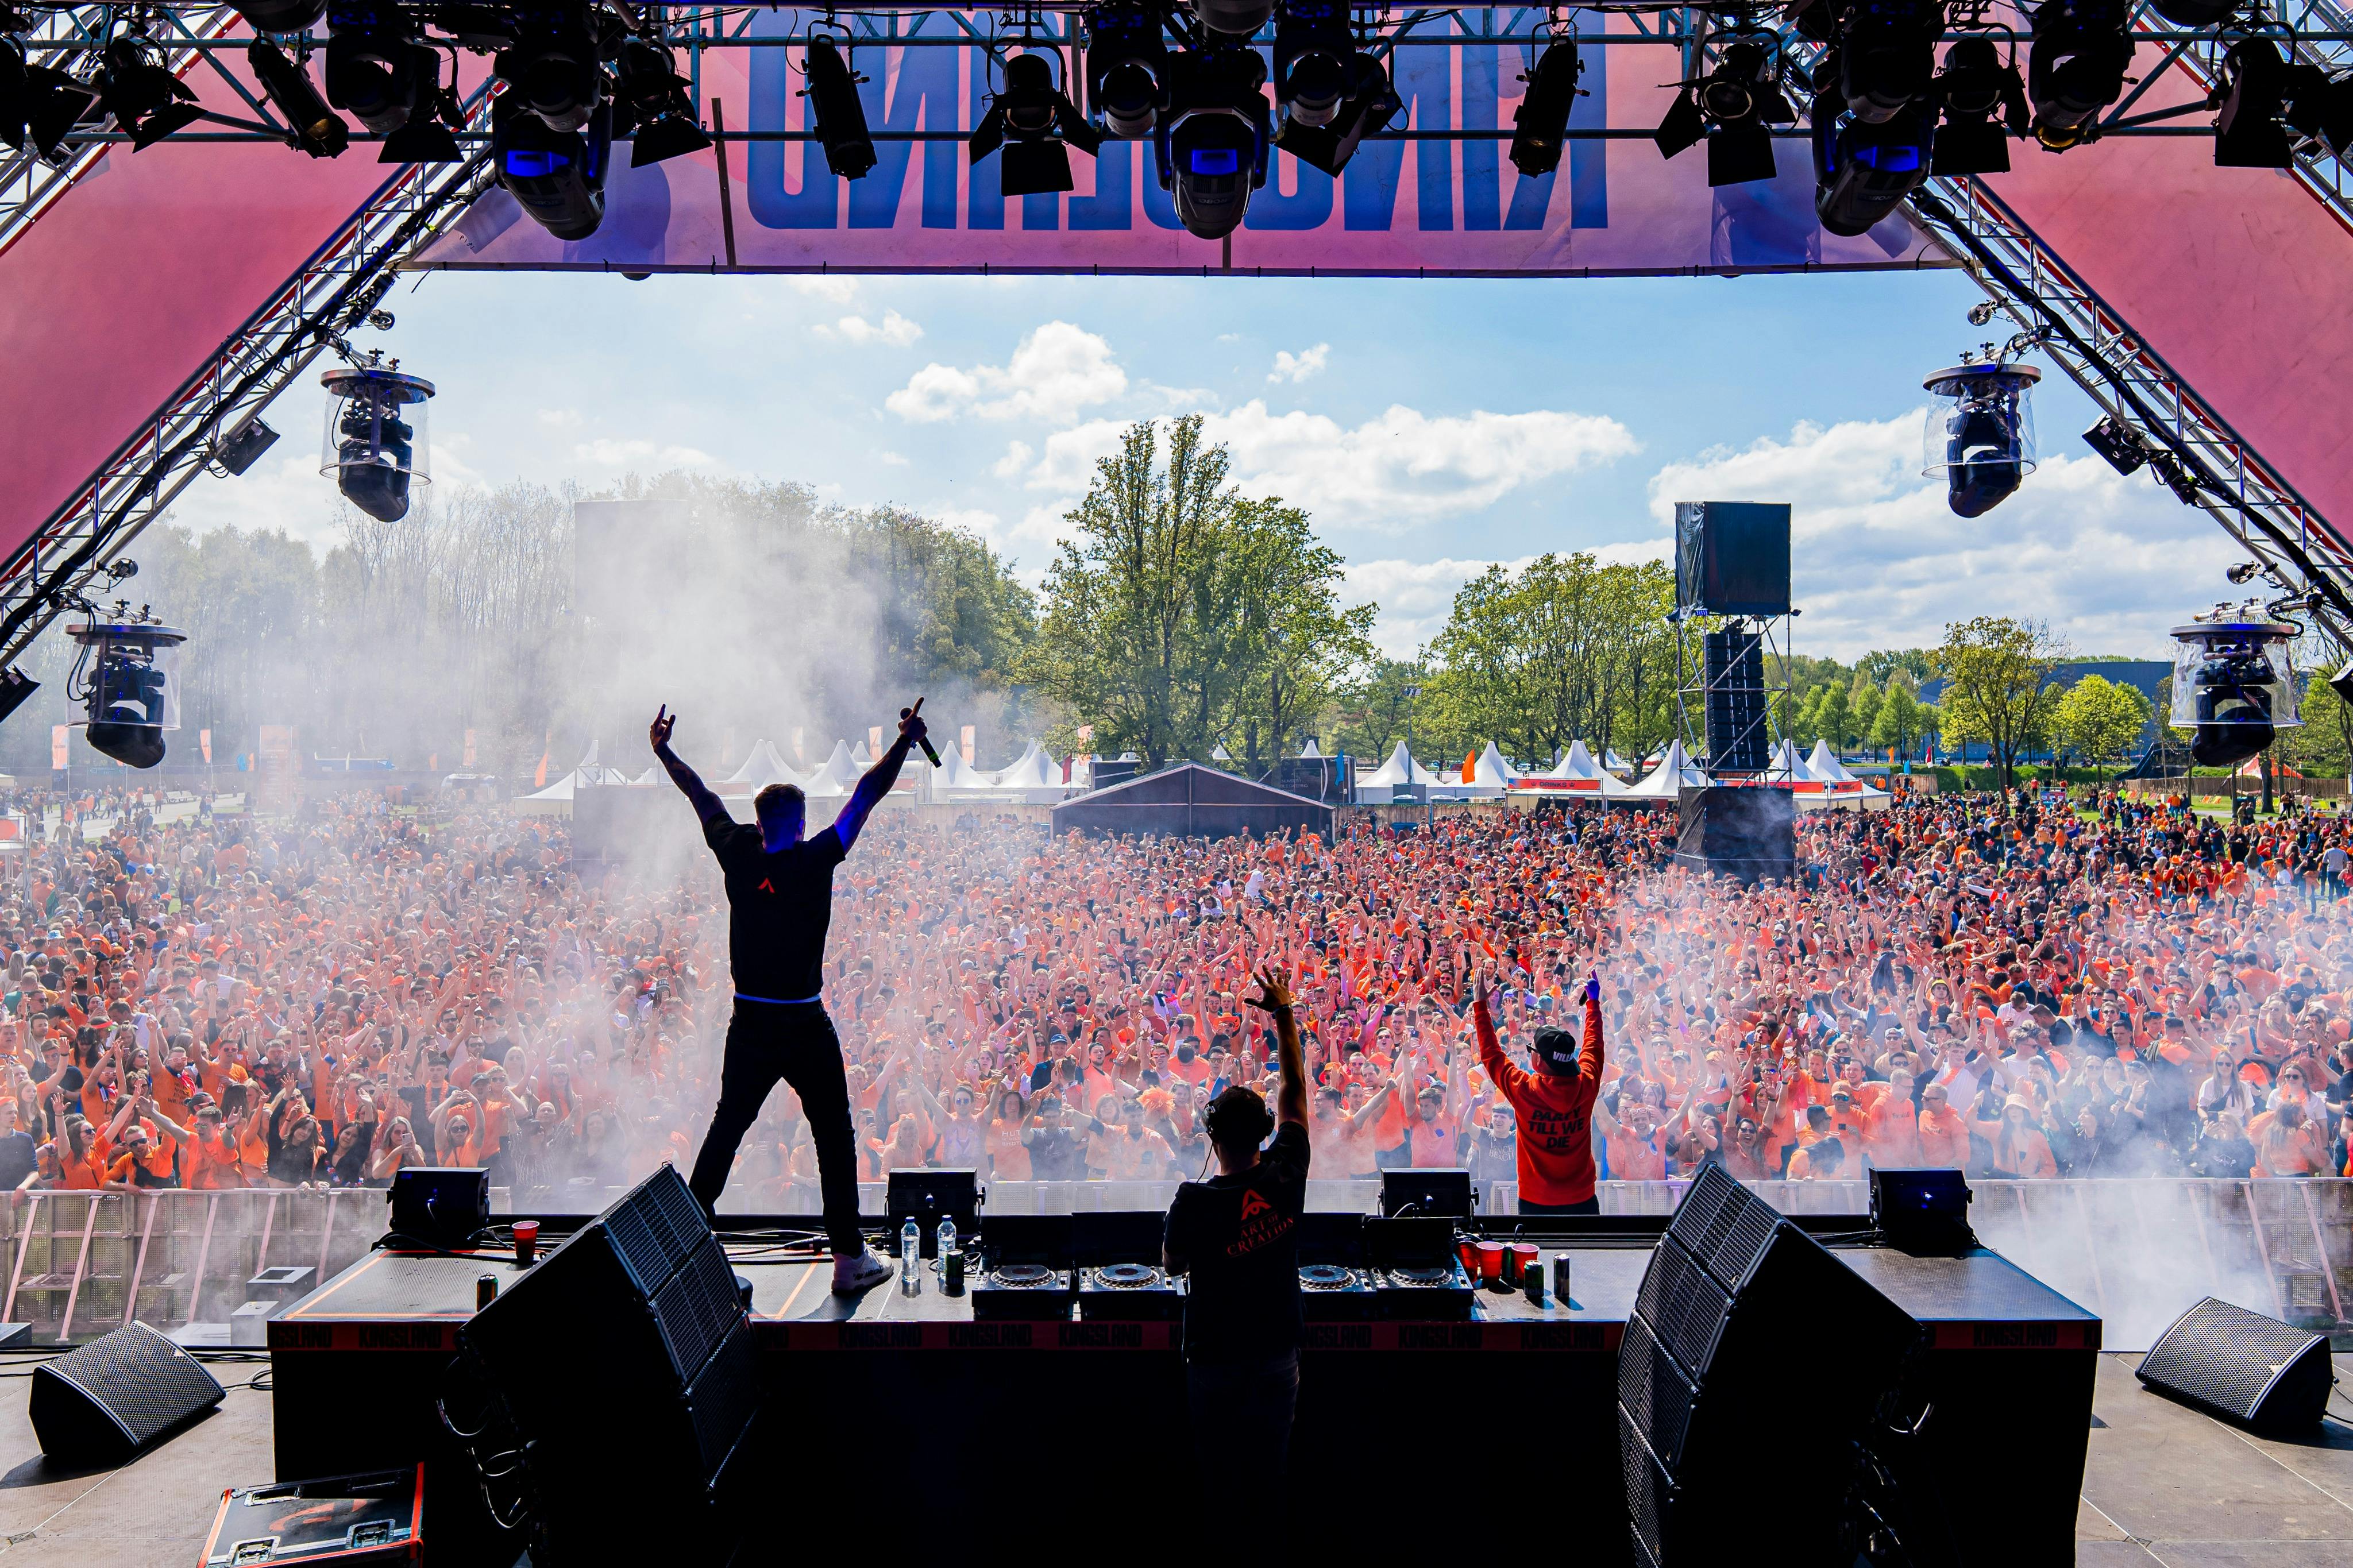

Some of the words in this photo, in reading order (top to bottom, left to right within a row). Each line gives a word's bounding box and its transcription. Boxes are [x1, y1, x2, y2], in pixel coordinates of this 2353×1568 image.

[1532, 1106, 1581, 1121] PARTY
[1528, 1121, 1558, 1135] TILL
[1563, 1117, 1585, 1134] WE
[1546, 1136, 1571, 1148] DIE
[1226, 1216, 1295, 1256] CREATION
[1240, 1219, 1266, 1239] ART
[358, 1325, 442, 1349] KINGSLAND
[948, 1324, 1033, 1347] KINGSLAND
[1058, 1324, 1142, 1347] KINGSLAND
[1973, 1324, 2057, 1346] KINGSLAND
